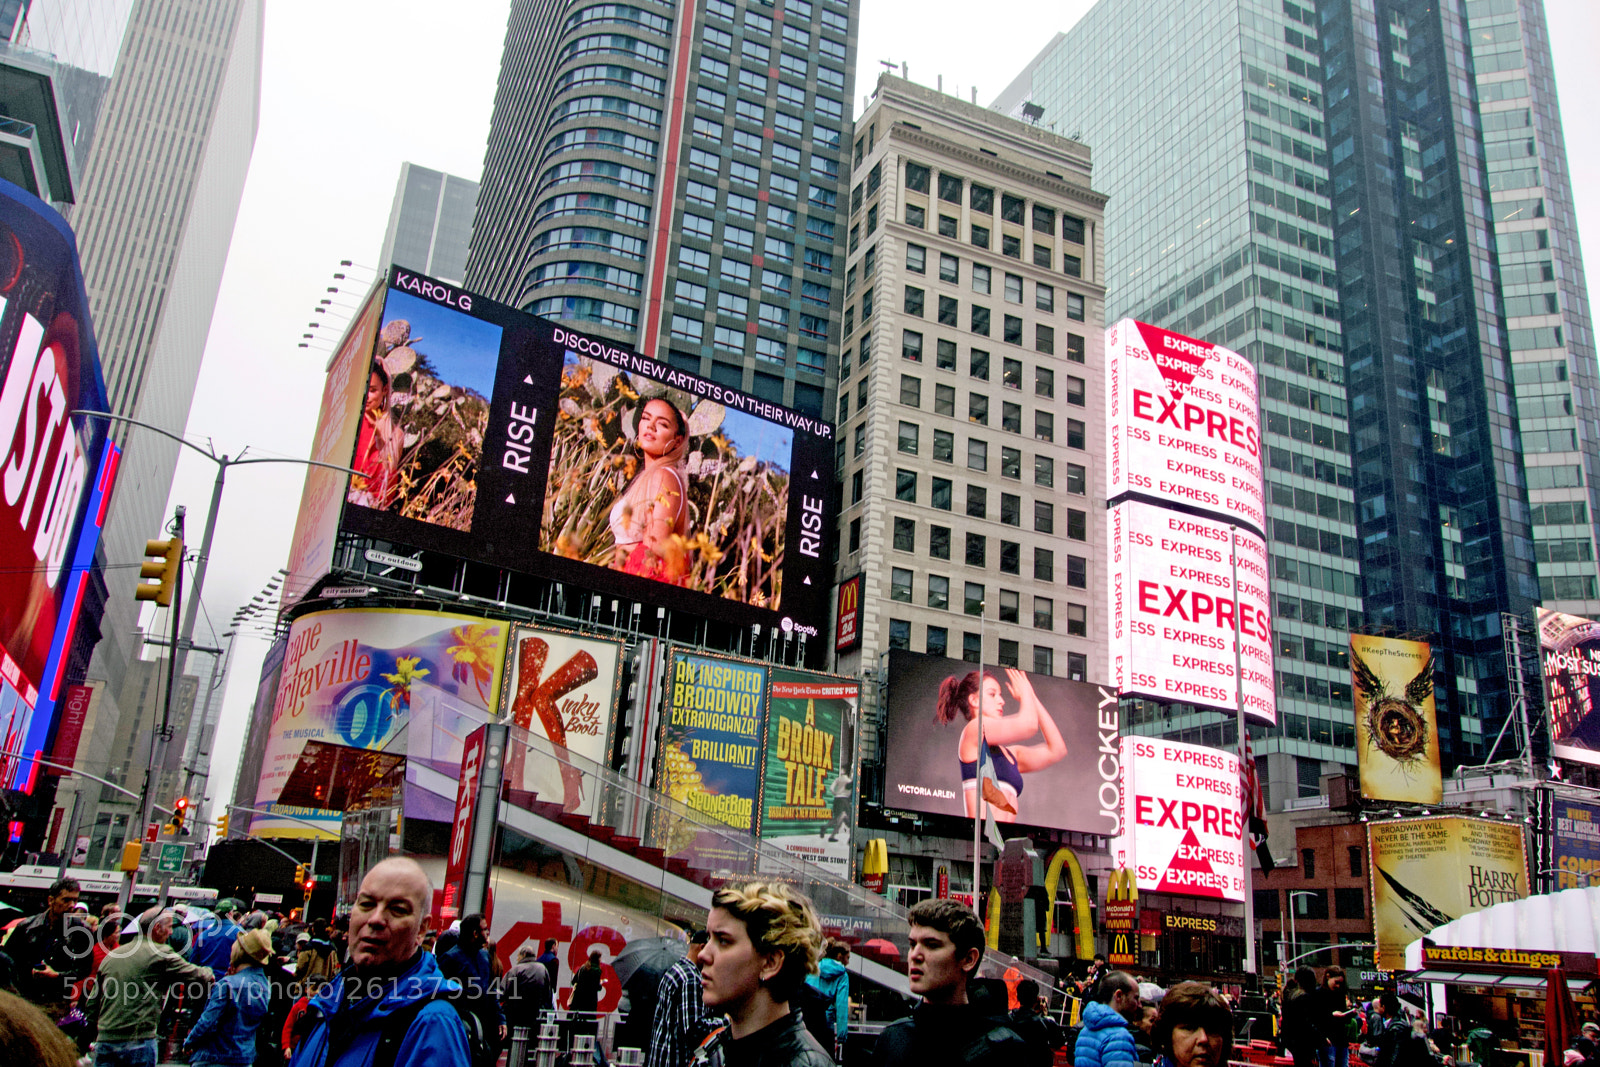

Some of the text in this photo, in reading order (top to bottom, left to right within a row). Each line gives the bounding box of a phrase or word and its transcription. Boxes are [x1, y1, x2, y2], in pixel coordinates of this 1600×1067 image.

[396, 272, 472, 312] KAROL G
[1163, 335, 1221, 362] EXPRESS
[1157, 353, 1214, 380] EXPRESS
[553, 328, 832, 439] DISCOVER NEW ARTISTS ON THEIR WAY UP.
[1111, 359, 1119, 417] EXPRESS
[1165, 377, 1222, 404] EXPRESS
[503, 402, 537, 473] RISE
[1158, 434, 1217, 459] EXPRESS
[1112, 425, 1120, 485] EXPRESS
[1167, 459, 1226, 484] EXPRESS
[1160, 481, 1219, 505] EXPRESS
[800, 495, 823, 558] RISE
[1169, 518, 1229, 542] EXPRESS
[371, 553, 418, 568] city outdoor
[1161, 539, 1222, 563] EXPRESS
[1170, 565, 1231, 588] EXPRESS
[1114, 573, 1122, 639] EXPRESS
[1164, 628, 1225, 650] EXPRESS
[1361, 646, 1422, 659] #KeepTheSecrets
[1173, 654, 1234, 677] EXPRESS
[699, 664, 762, 694] INSPIRED
[782, 685, 792, 693] New
[793, 686, 805, 695] York
[845, 686, 858, 694] PICK
[1165, 679, 1227, 701] EXPRESS
[673, 683, 760, 717] BROADWAY
[805, 698, 815, 727] A
[283, 728, 325, 739] THE MUSICAL
[564, 717, 604, 736] Boots
[777, 715, 834, 771] BRONX
[1164, 747, 1224, 770] EXPRESS
[785, 760, 827, 807] TALE
[897, 784, 956, 799] VICTORIA ARLEN
[1176, 774, 1232, 796] EXPRESS
[453, 741, 479, 866] tkts
[1424, 822, 1443, 830] WILL
[1557, 817, 1573, 831] BEST
[1375, 834, 1398, 843] NEVER
[1411, 832, 1426, 840] THE
[1462, 836, 1491, 845] BROADWAY
[790, 845, 819, 854] COMBINATION
[801, 854, 816, 862] WEST
[817, 855, 829, 863] SIDE
[830, 856, 847, 864] STORY
[1177, 844, 1235, 865] EXPRESS
[1166, 869, 1228, 889] EXPRESS
[1469, 865, 1519, 891] HARRY
[855, 921, 872, 930] ATM
[1166, 915, 1217, 931] EXPRESS
[1360, 971, 1389, 981] GIFTS
